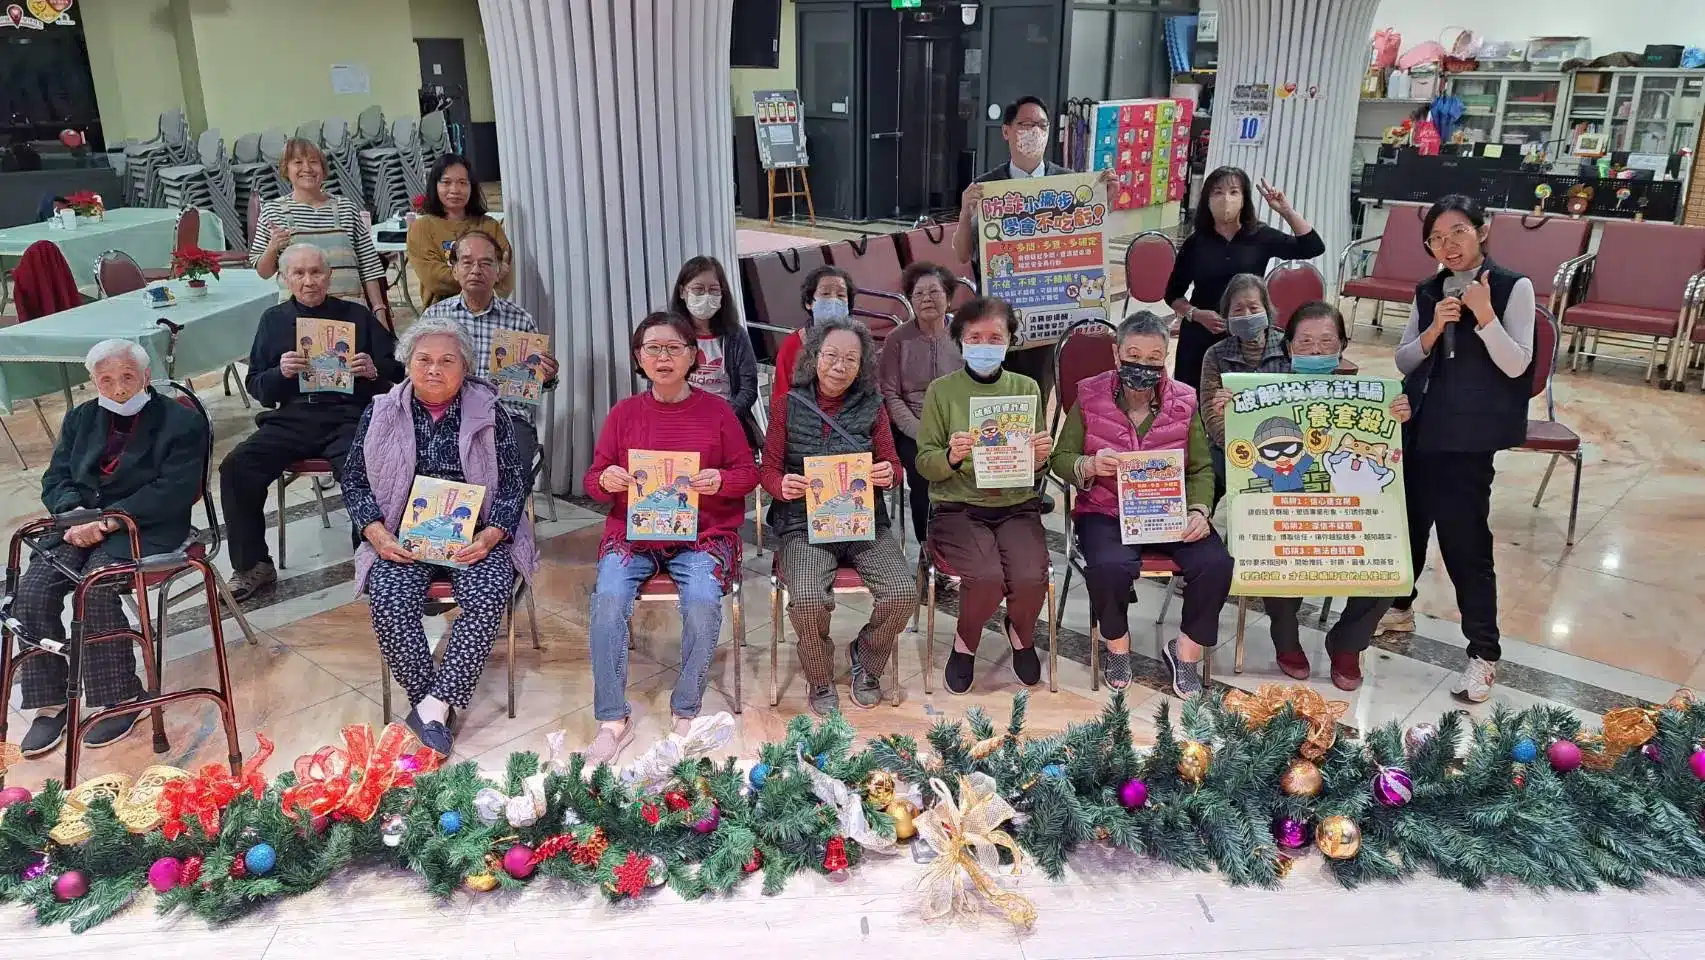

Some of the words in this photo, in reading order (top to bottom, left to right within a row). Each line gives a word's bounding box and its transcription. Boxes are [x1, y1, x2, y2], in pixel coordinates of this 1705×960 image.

[1240, 117, 1258, 139] 10
[982, 189, 1074, 221] 防詐小撇步
[1233, 380, 1384, 413] 破解投資詐騙
